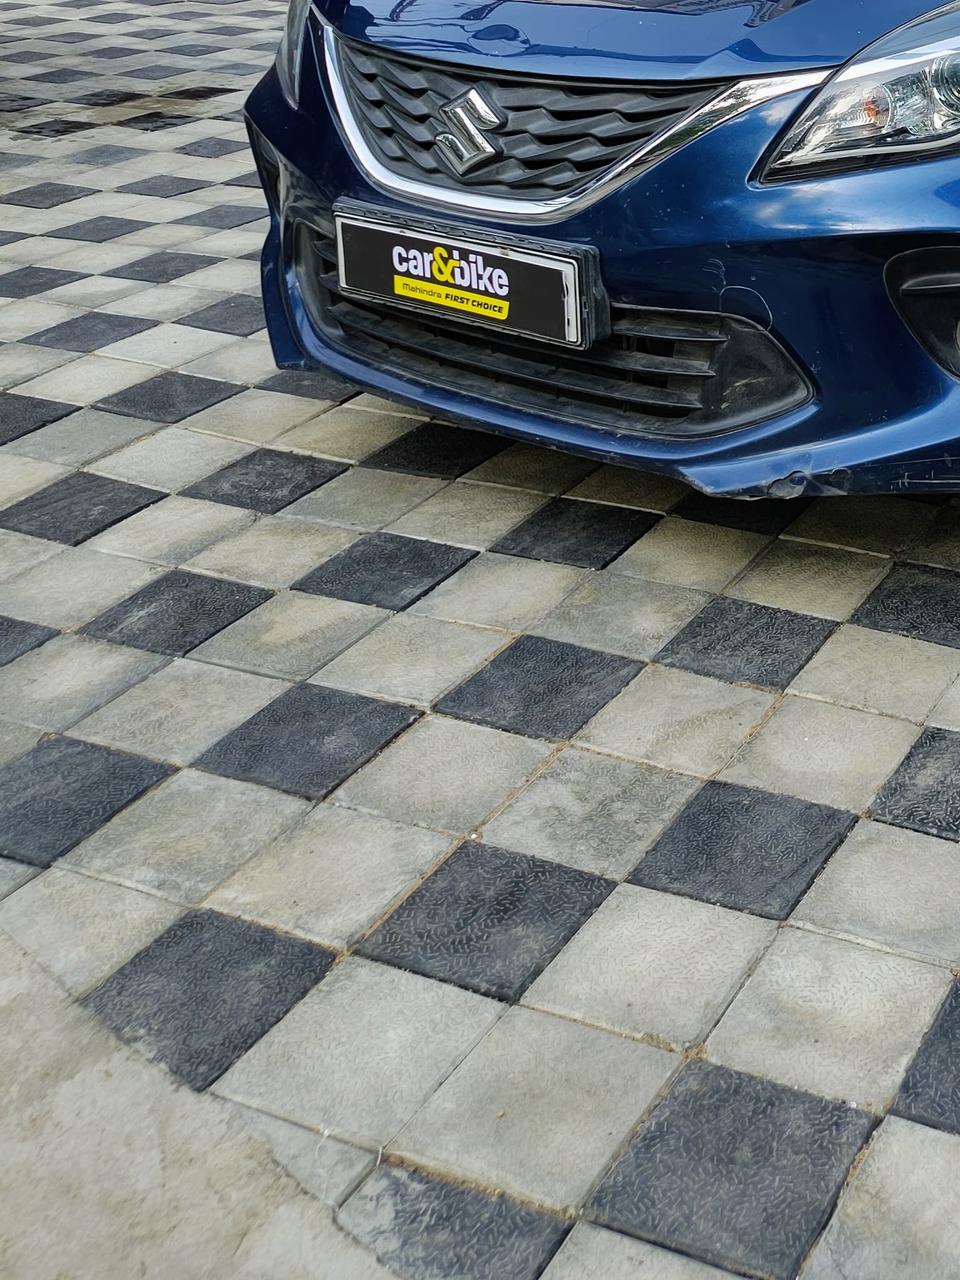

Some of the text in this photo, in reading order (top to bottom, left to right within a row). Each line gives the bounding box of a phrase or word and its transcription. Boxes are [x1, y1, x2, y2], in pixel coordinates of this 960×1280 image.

[392, 245, 509, 296] car&bike
[444, 293, 471, 306] FIRST
[471, 299, 504, 314] CHOICE
